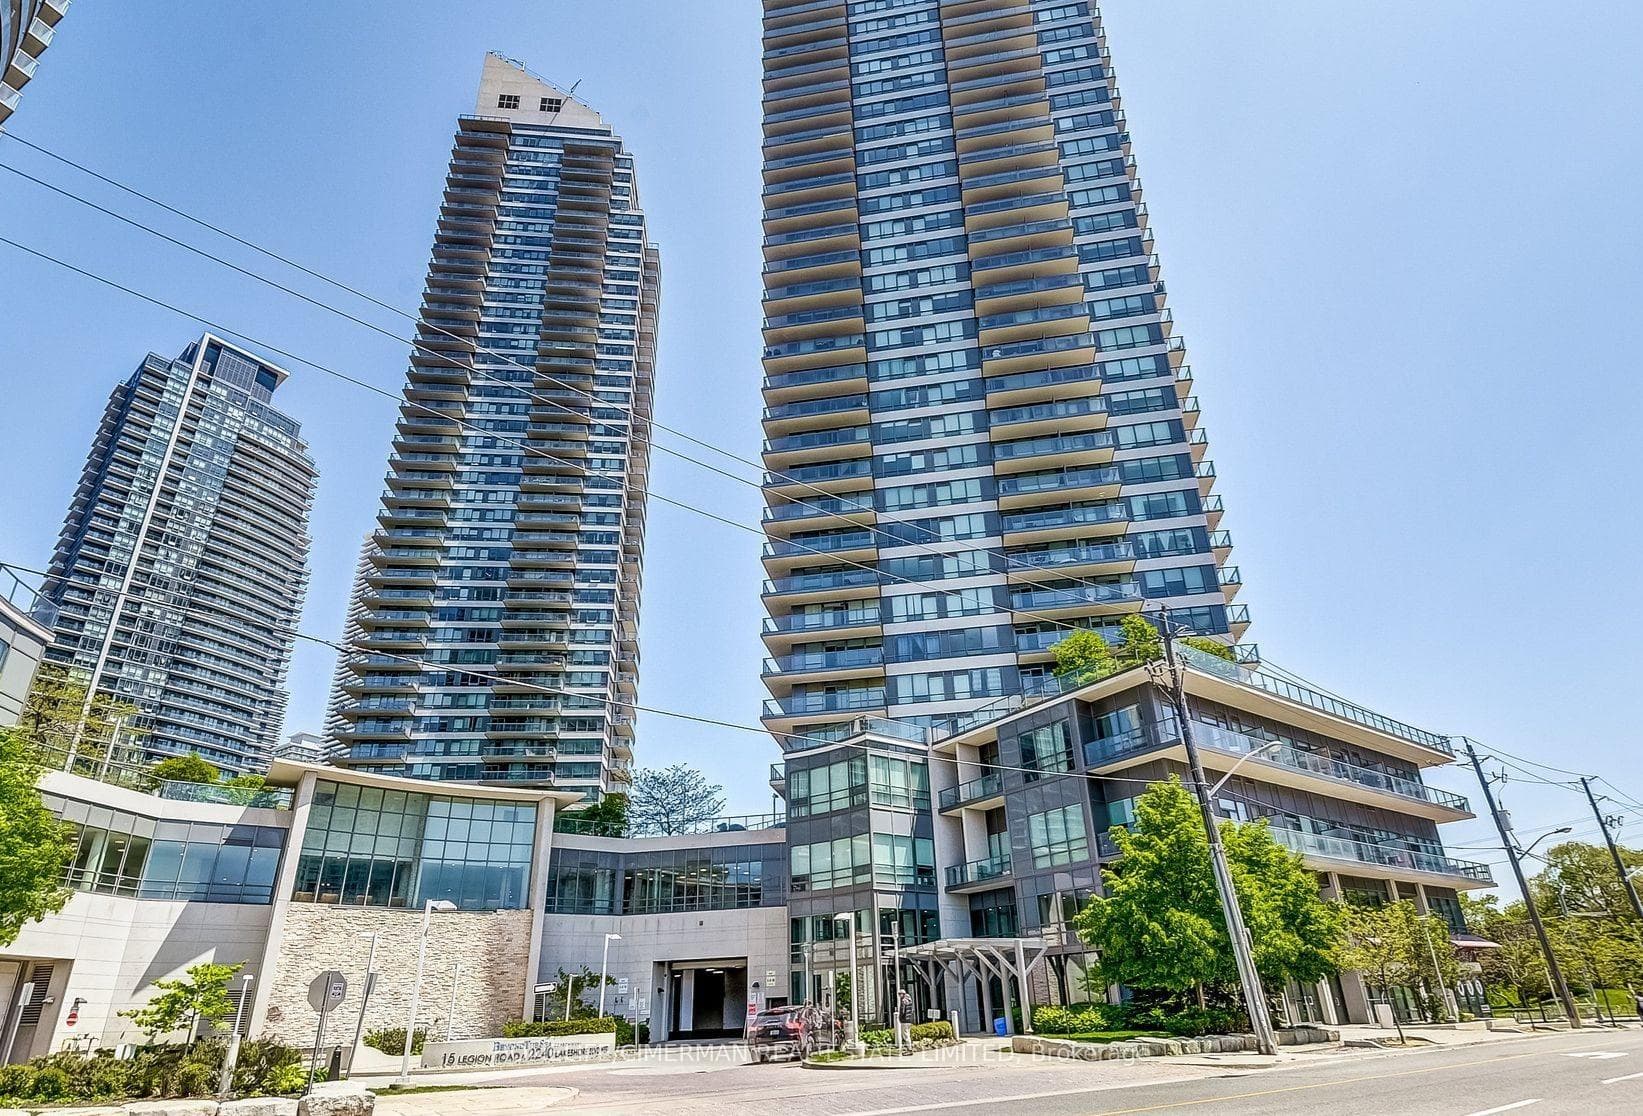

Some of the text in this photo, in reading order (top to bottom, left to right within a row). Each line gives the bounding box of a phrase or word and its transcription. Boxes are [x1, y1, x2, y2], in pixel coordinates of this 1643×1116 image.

[442, 1052, 456, 1067] 15
[457, 1053, 492, 1066] LEGION
[494, 1052, 521, 1064] ROAD
[528, 1046, 554, 1061] 2240
